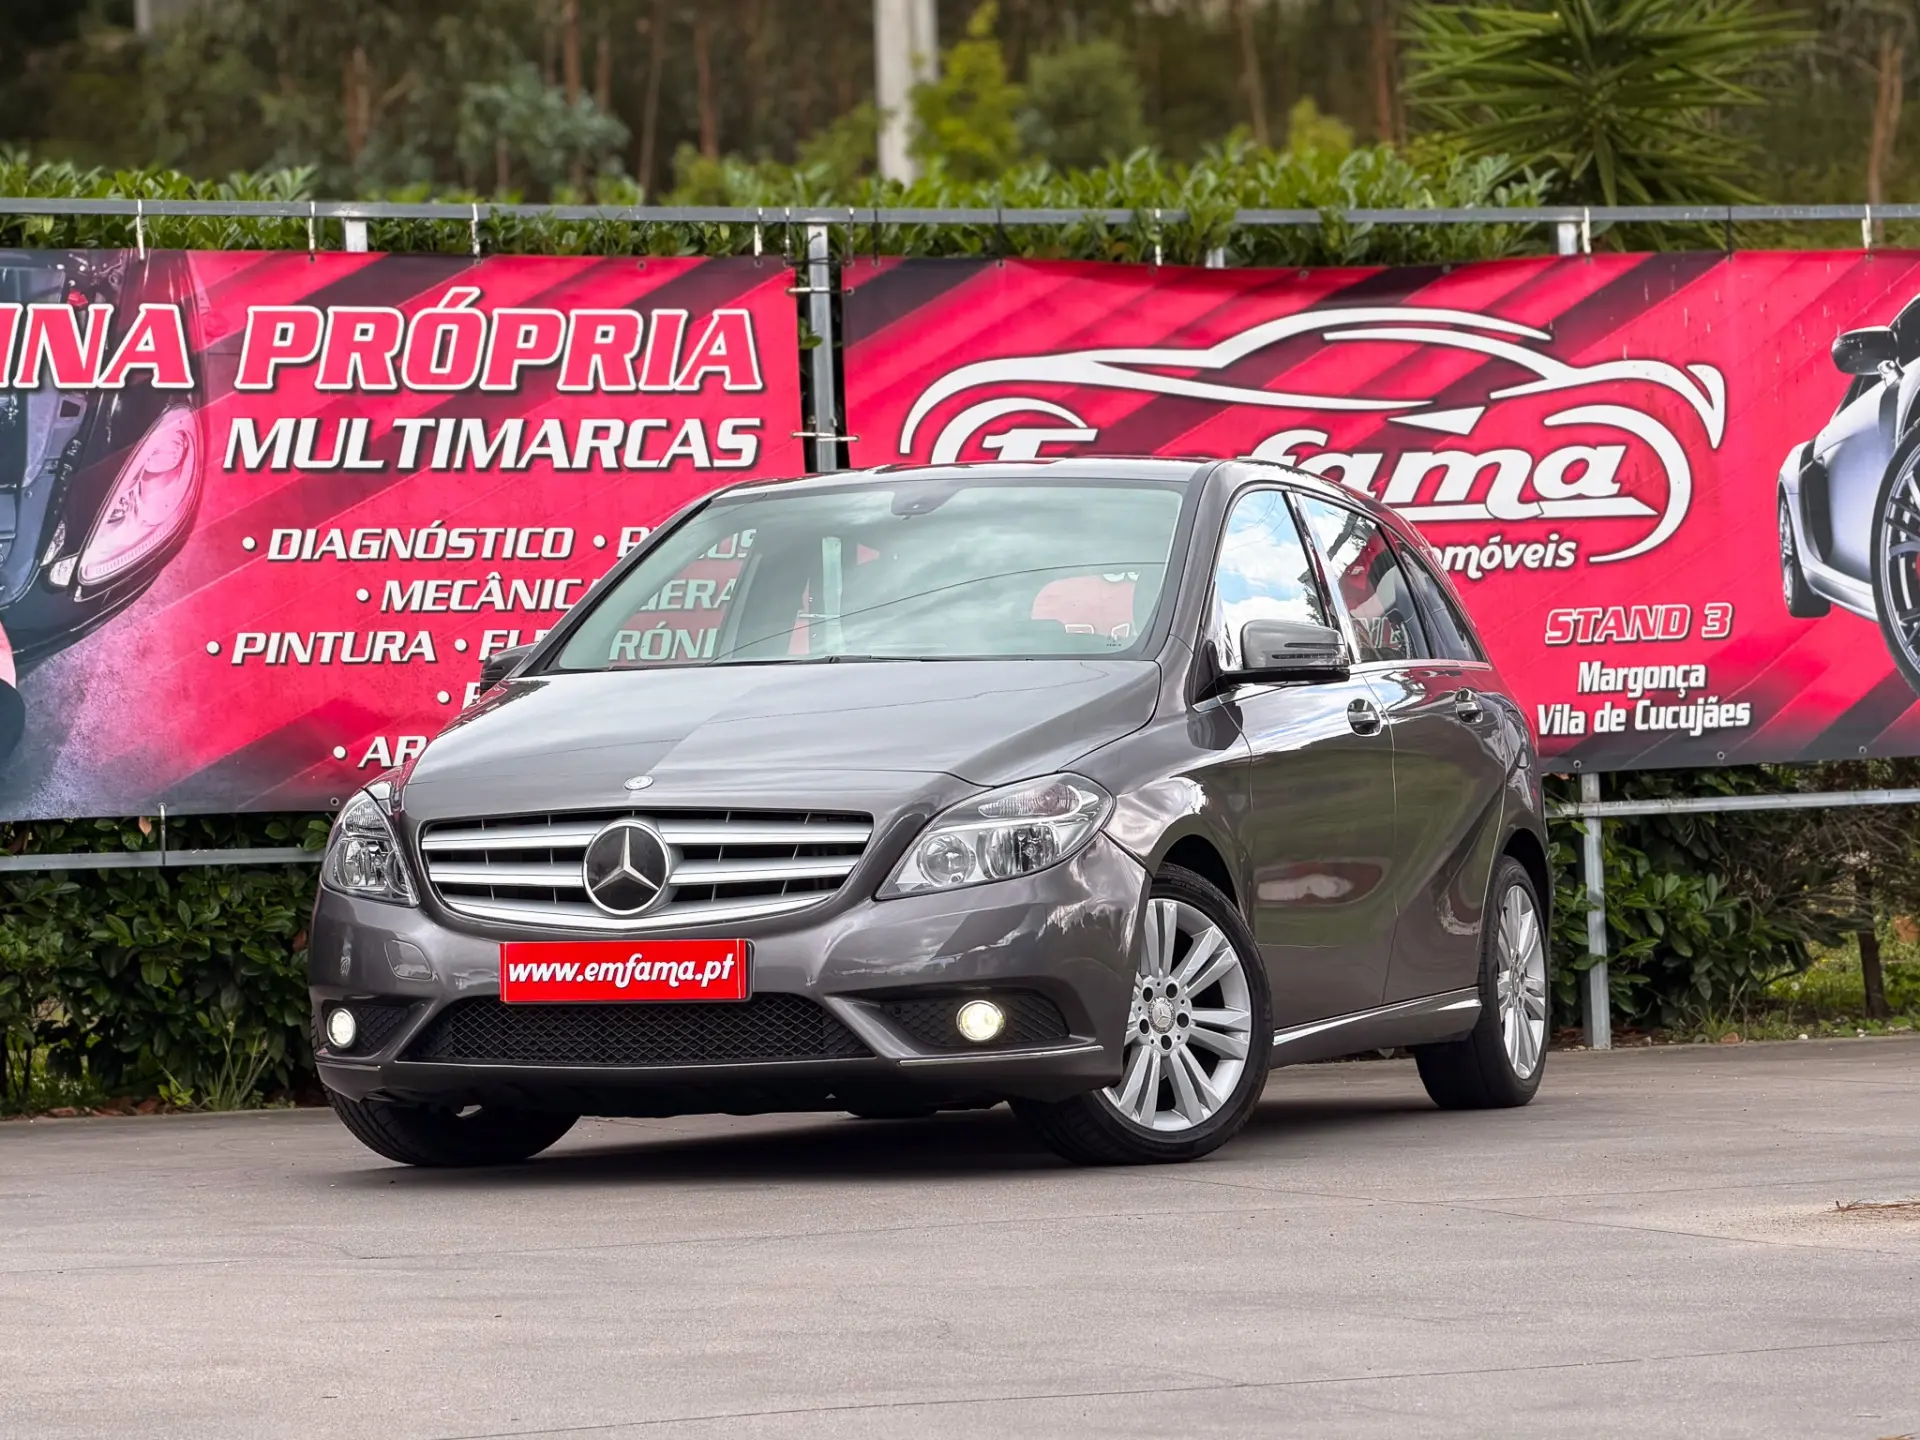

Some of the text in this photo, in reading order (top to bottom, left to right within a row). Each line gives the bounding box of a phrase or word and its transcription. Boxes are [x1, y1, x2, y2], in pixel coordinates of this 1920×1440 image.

[234, 287, 762, 391] PRÓPRIA
[223, 417, 762, 468] MULTIMARCAS
[266, 520, 575, 560] DIAGNÓSTICO
[380, 572, 605, 612] MECÂNIC
[1544, 602, 1733, 644] STAND 3
[231, 630, 437, 664] PINTURA
[1577, 660, 1706, 698] Margonça
[1537, 695, 1751, 737] Vila de Cucujães
[508, 953, 735, 989] www.emfama.pt
